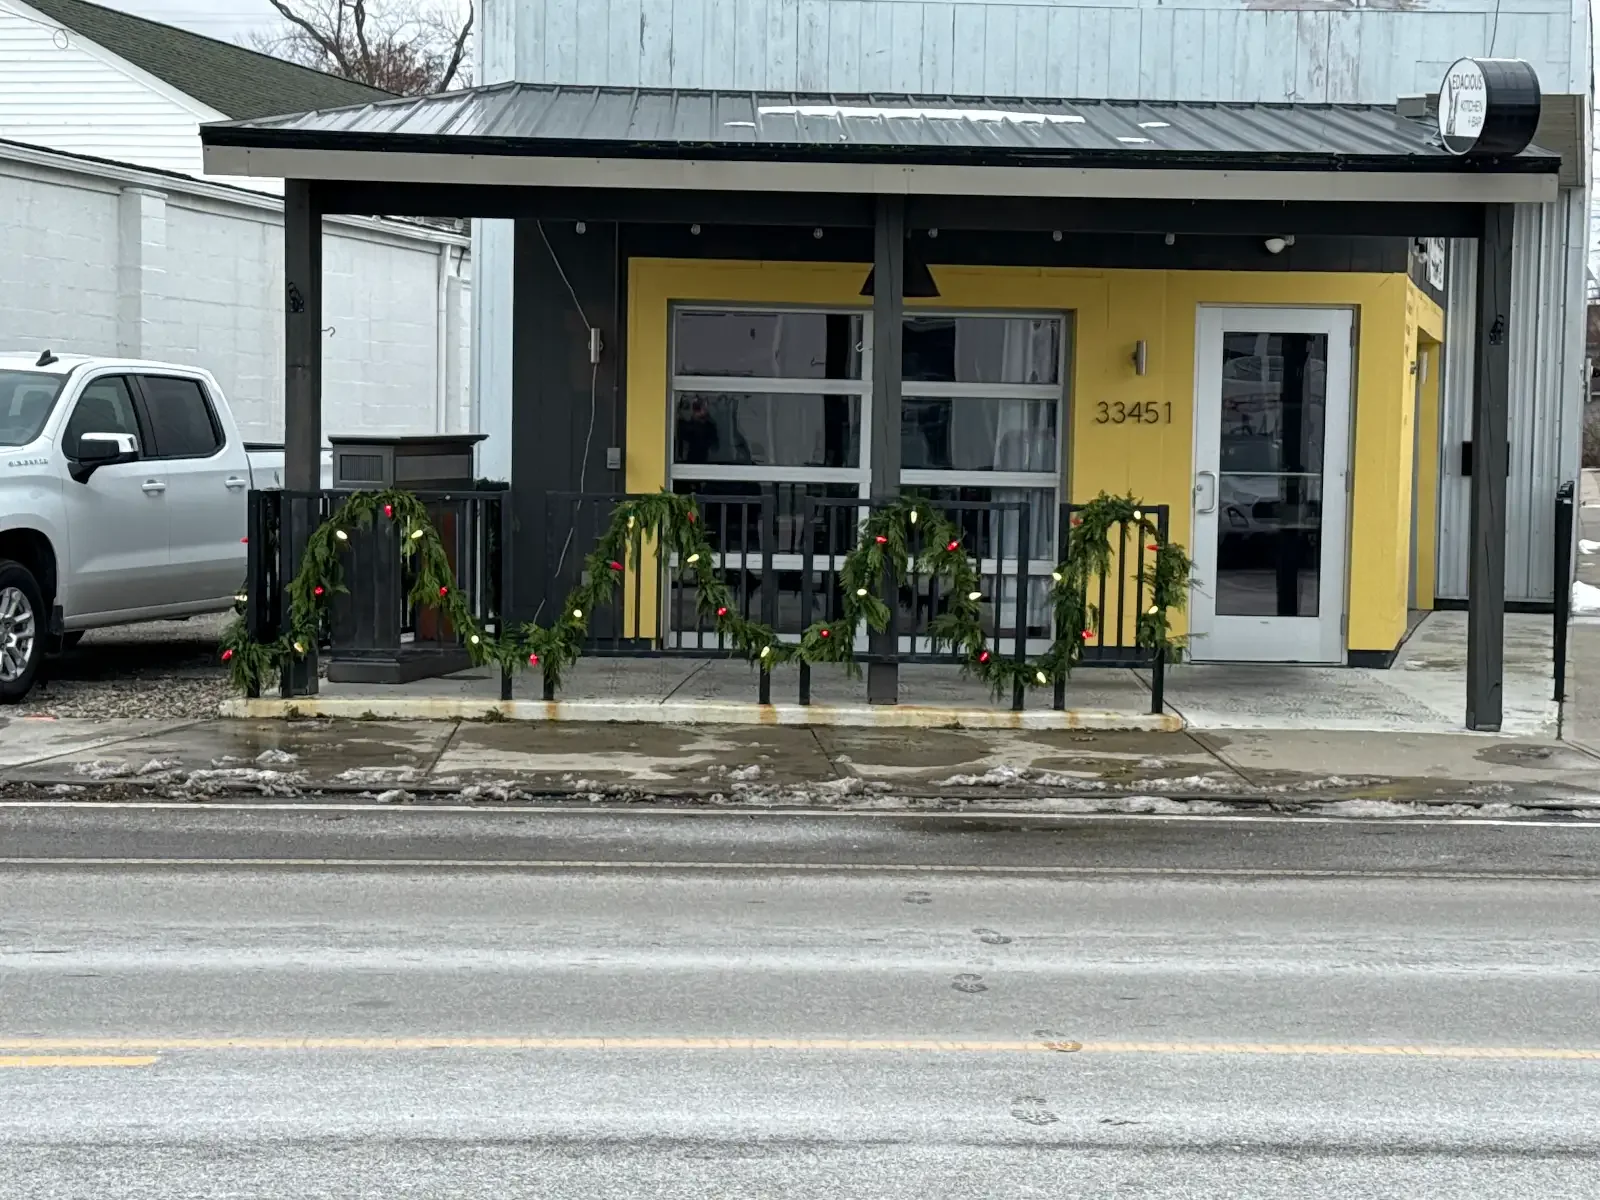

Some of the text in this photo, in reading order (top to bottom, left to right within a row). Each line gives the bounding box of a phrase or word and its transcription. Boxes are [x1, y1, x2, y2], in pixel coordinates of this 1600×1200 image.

[1452, 73, 1483, 90] EDACIOUS
[1461, 99, 1483, 112] KITCHEN
[1095, 401, 1171, 424] 33451
